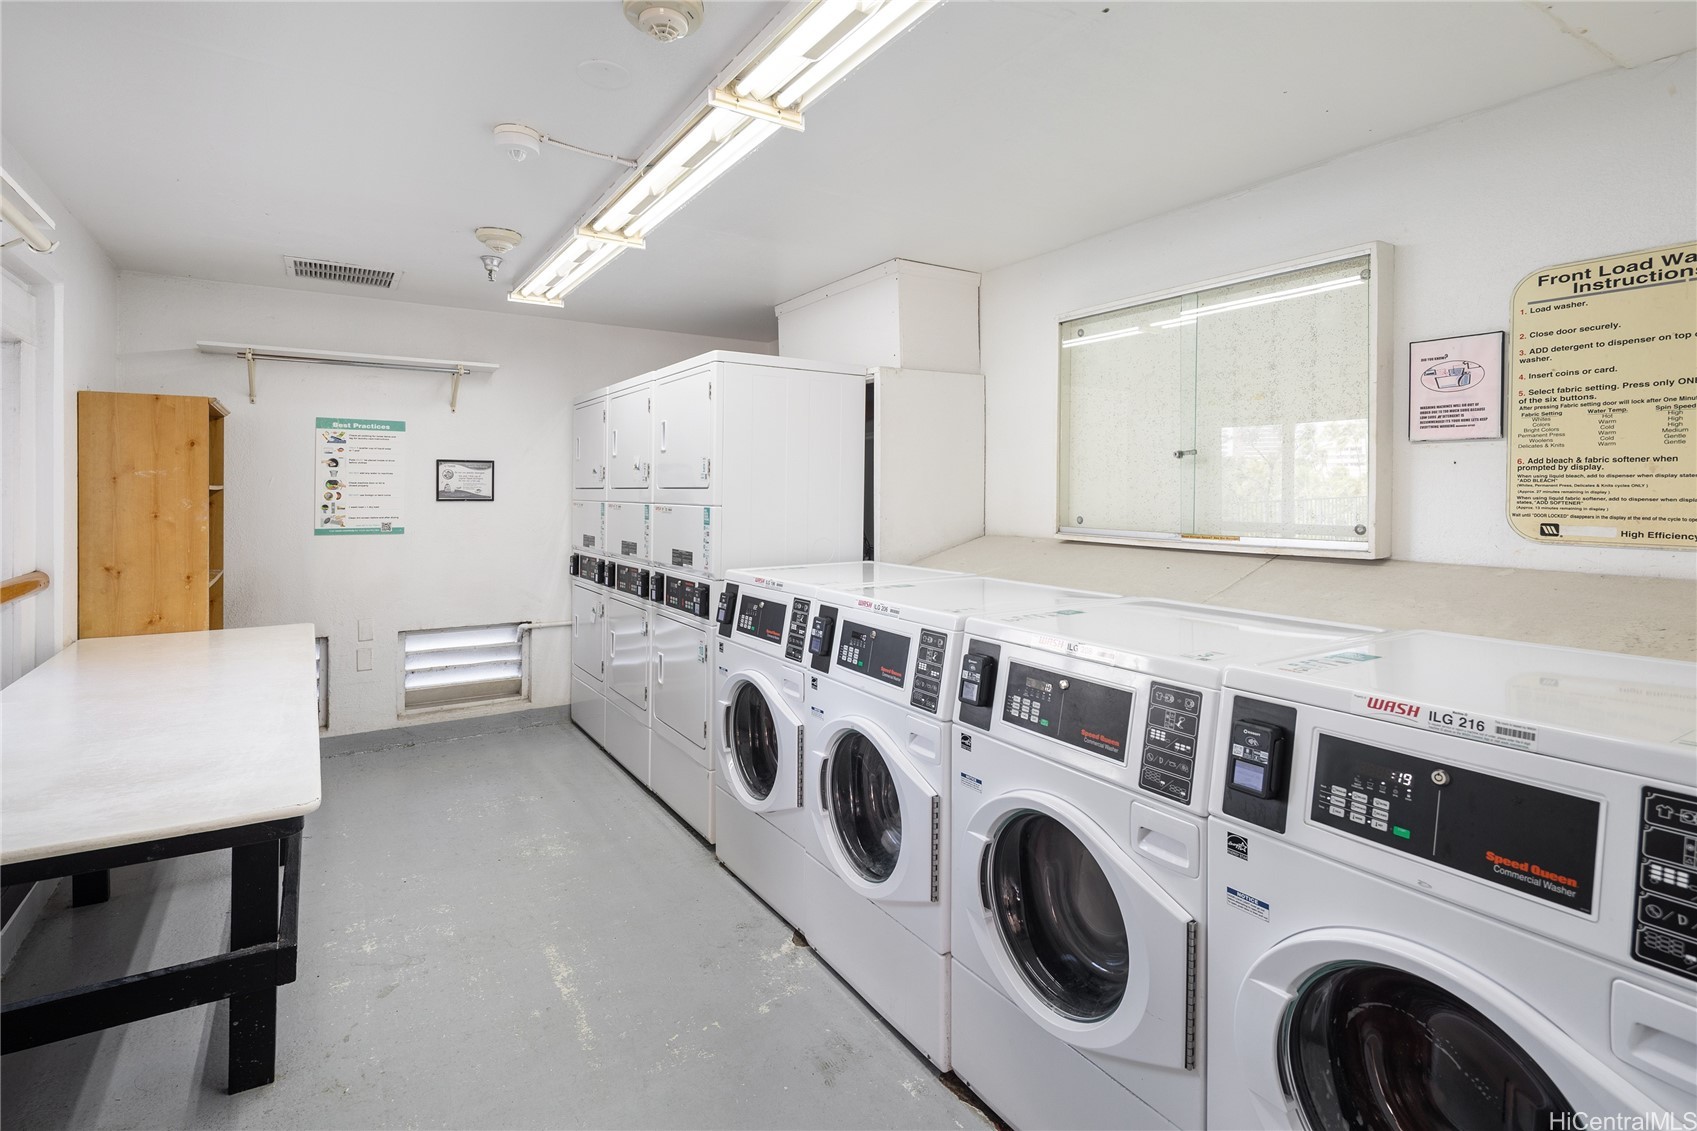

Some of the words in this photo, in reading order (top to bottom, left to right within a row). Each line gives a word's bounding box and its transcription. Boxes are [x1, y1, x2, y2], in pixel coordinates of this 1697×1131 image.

[1538, 268, 1592, 286] Front
[1599, 258, 1653, 278] Load
[1574, 268, 1697, 294] Instruction
[1530, 305, 1552, 314] Load
[1554, 301, 1588, 311] washer.
[1580, 322, 1621, 332] securely.
[1529, 346, 1548, 354] ADD
[1551, 342, 1593, 352] detergent
[1608, 336, 1656, 346] dispenser
[1653, 379, 1675, 387] only
[1620, 531, 1644, 539] High
[858, 599, 873, 609] WASH
[1067, 643, 1078, 652] ILG
[1367, 696, 1421, 718] WASH
[1428, 711, 1453, 725] ILG
[1458, 717, 1485, 732] 216
[1081, 728, 1100, 742] Speed
[1100, 735, 1120, 746] Queen
[1084, 737, 1104, 749] Commercial
[1105, 744, 1119, 753] Washer
[1486, 851, 1529, 872] Speed
[1531, 865, 1577, 888] Queen
[1493, 864, 1541, 886] Commercial
[1543, 880, 1576, 898] Washer
[1236, 892, 1258, 904] NOTICE
